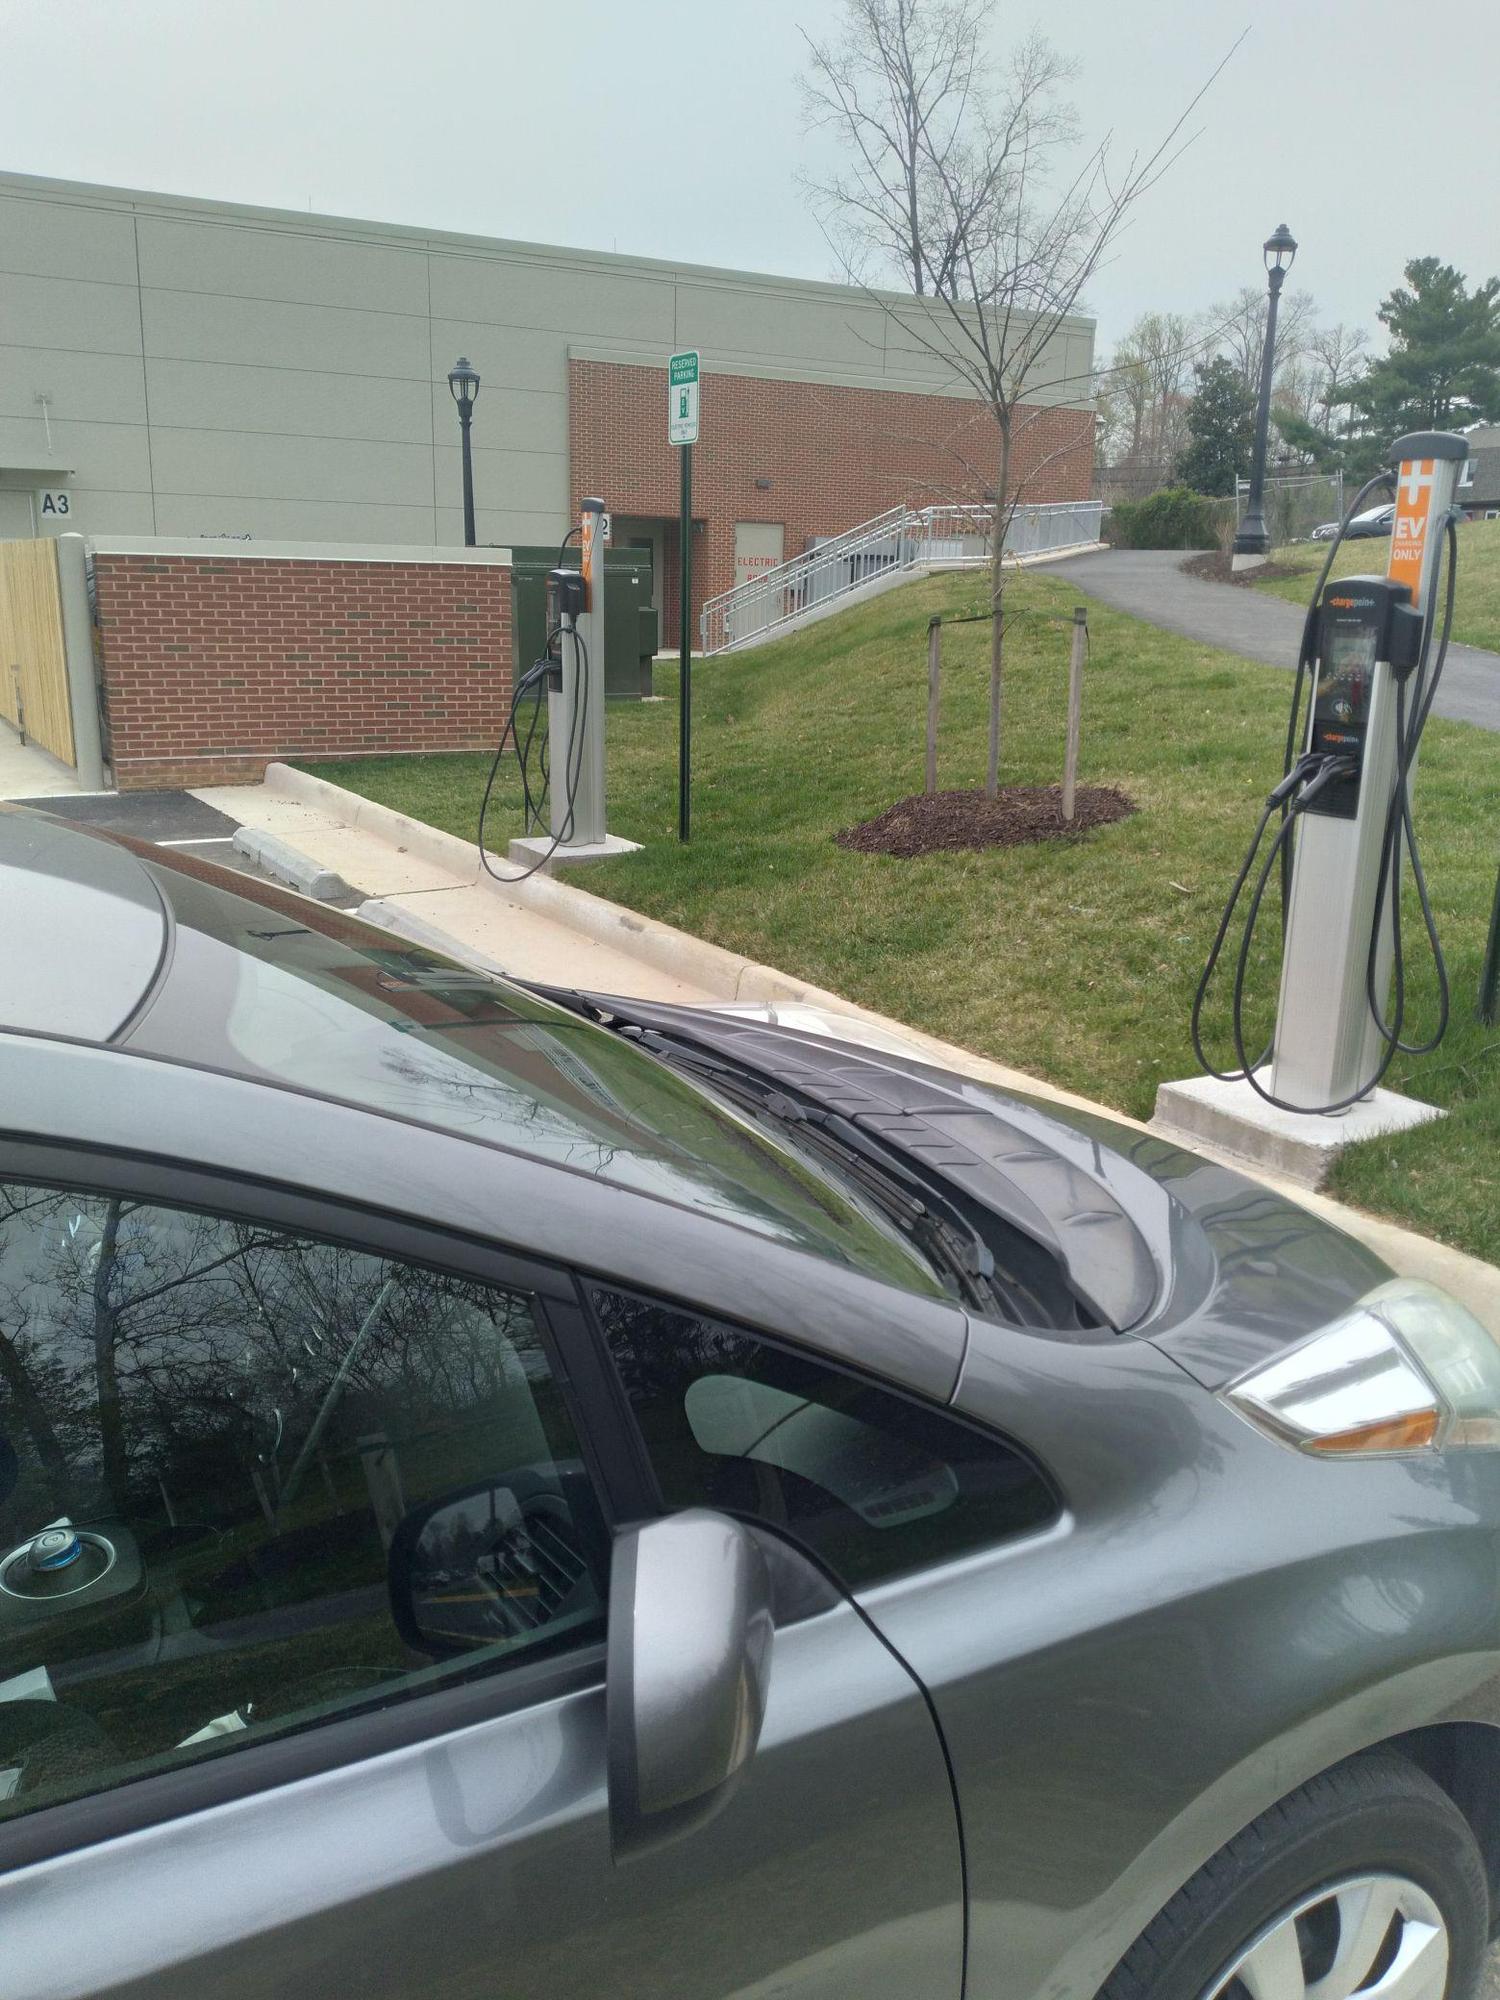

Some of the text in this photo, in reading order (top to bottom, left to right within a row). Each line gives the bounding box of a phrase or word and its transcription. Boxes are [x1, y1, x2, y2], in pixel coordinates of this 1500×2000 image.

[672, 357, 696, 370] RESERVED
[673, 369, 695, 381] PARKING
[42, 493, 69, 514] A3
[1396, 517, 1425, 538] EV
[1393, 549, 1422, 560] ONLY
[737, 557, 778, 567] ELECTRIC
